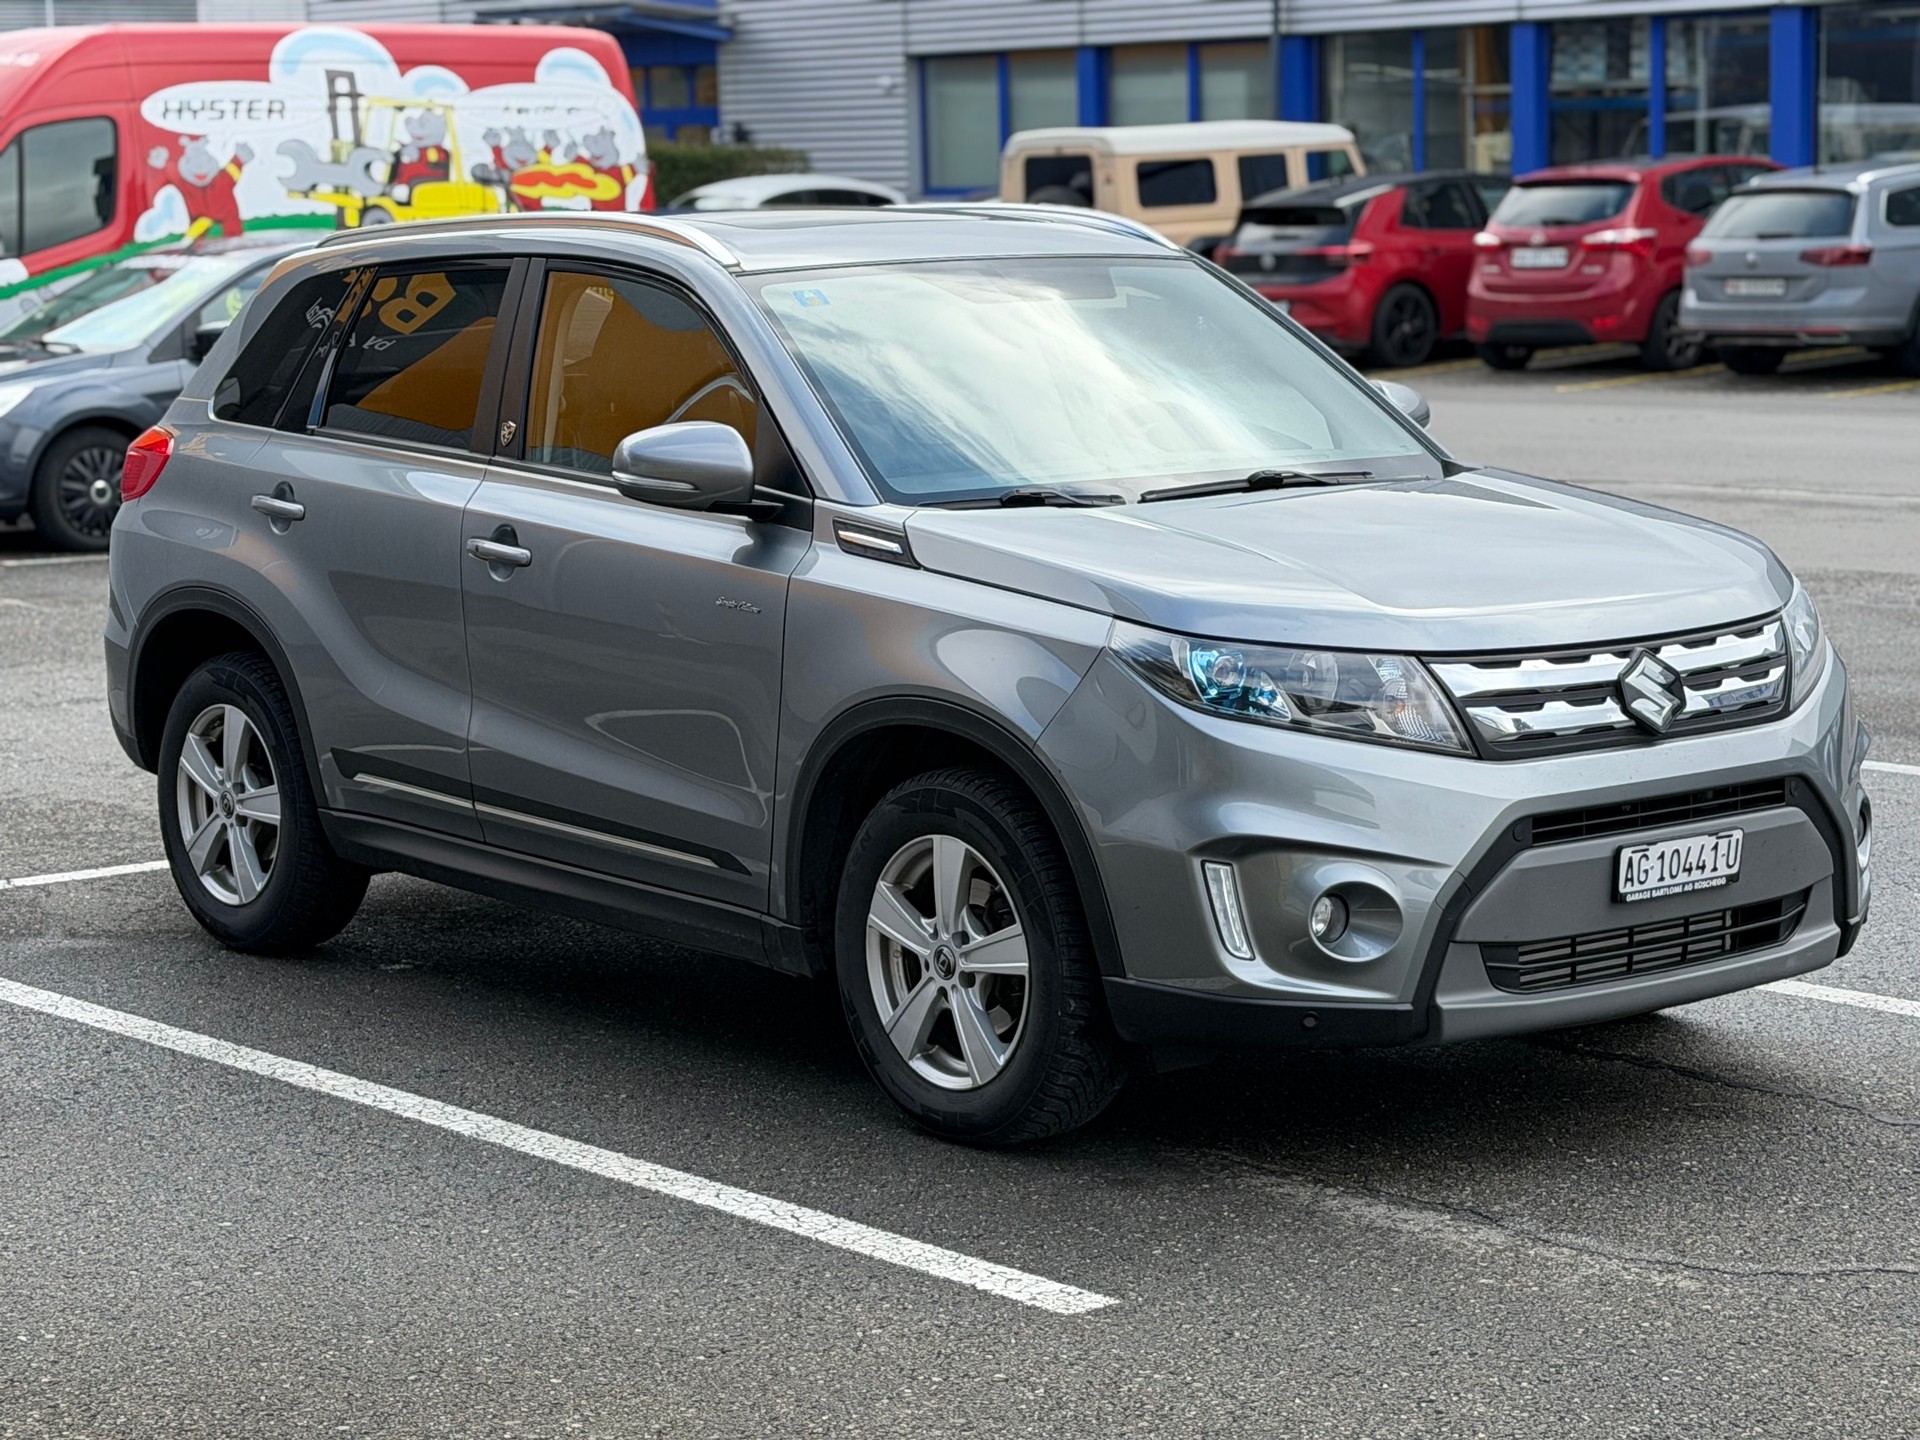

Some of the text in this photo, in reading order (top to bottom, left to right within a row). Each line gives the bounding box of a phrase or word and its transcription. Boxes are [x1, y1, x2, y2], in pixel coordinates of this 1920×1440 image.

[162, 99, 286, 121] HYSTER
[1623, 853, 1650, 889] AG
[1656, 841, 1719, 883] 10441
[1626, 890, 1651, 902] GARAGE
[1683, 882, 1693, 892] AG
